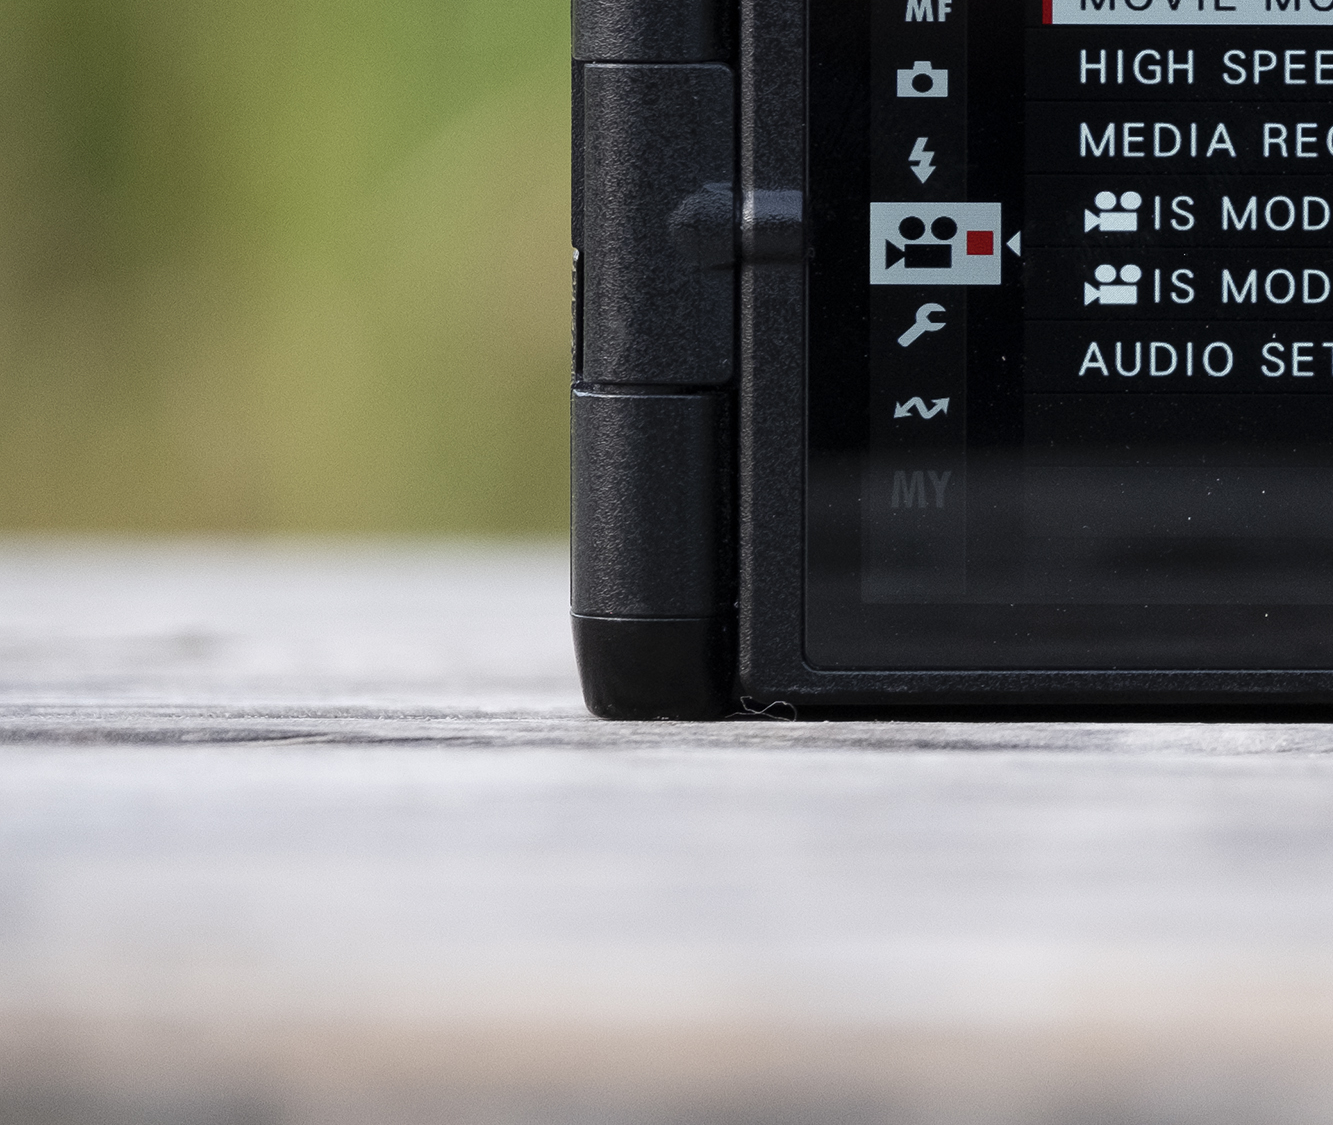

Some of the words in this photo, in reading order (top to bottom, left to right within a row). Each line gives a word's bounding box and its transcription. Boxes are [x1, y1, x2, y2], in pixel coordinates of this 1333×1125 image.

[1080, 48, 1194, 85] HIGH
[1080, 122, 1237, 158] MEDIA
[1154, 195, 1195, 231] IS
[1154, 268, 1195, 304] IS
[1078, 341, 1234, 377] AUDIO
[889, 469, 953, 509] MY
